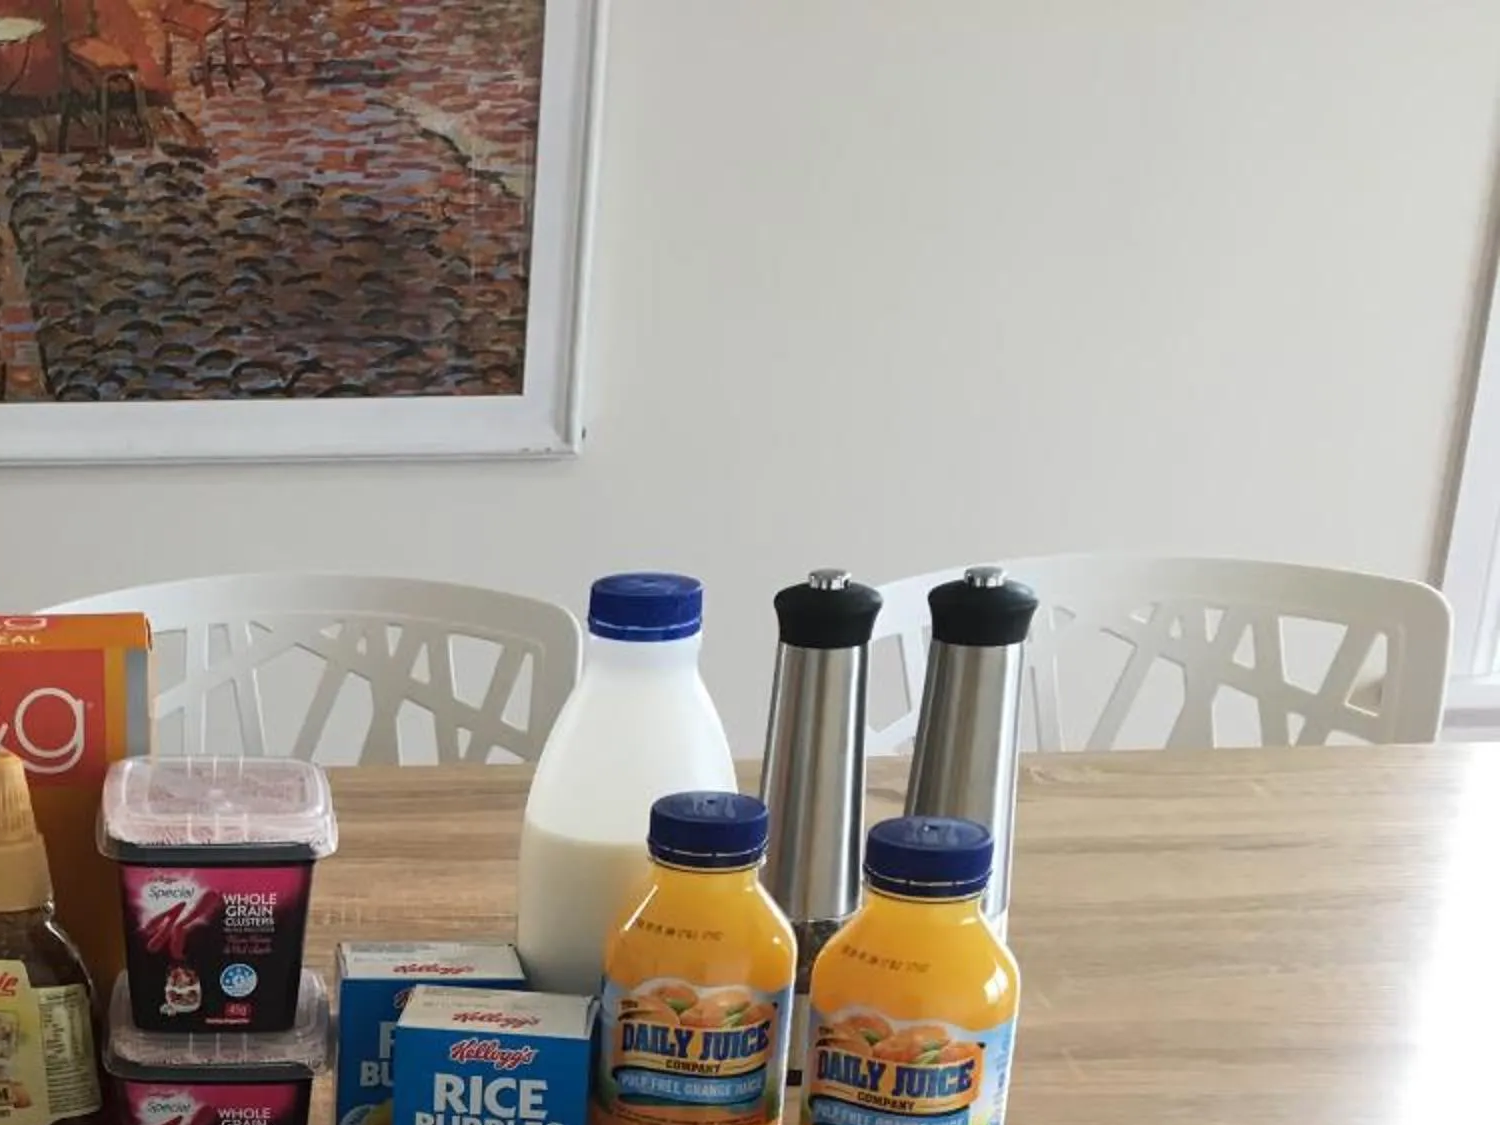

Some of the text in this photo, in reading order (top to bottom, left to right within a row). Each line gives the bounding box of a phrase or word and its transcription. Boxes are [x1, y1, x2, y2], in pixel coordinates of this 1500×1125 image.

[148, 885, 195, 900] Special
[223, 892, 277, 905] WHOLE
[225, 904, 274, 917] GRAIN
[621, 1020, 770, 1061] DAILY JUICE
[450, 1037, 540, 1069] Kellogg's
[665, 1058, 722, 1073] COMPANY
[816, 1049, 975, 1098] DAILY JUICE
[434, 1073, 549, 1121] RICE
[856, 1091, 916, 1111] COMPANY
[217, 1107, 271, 1120] WHOLE
